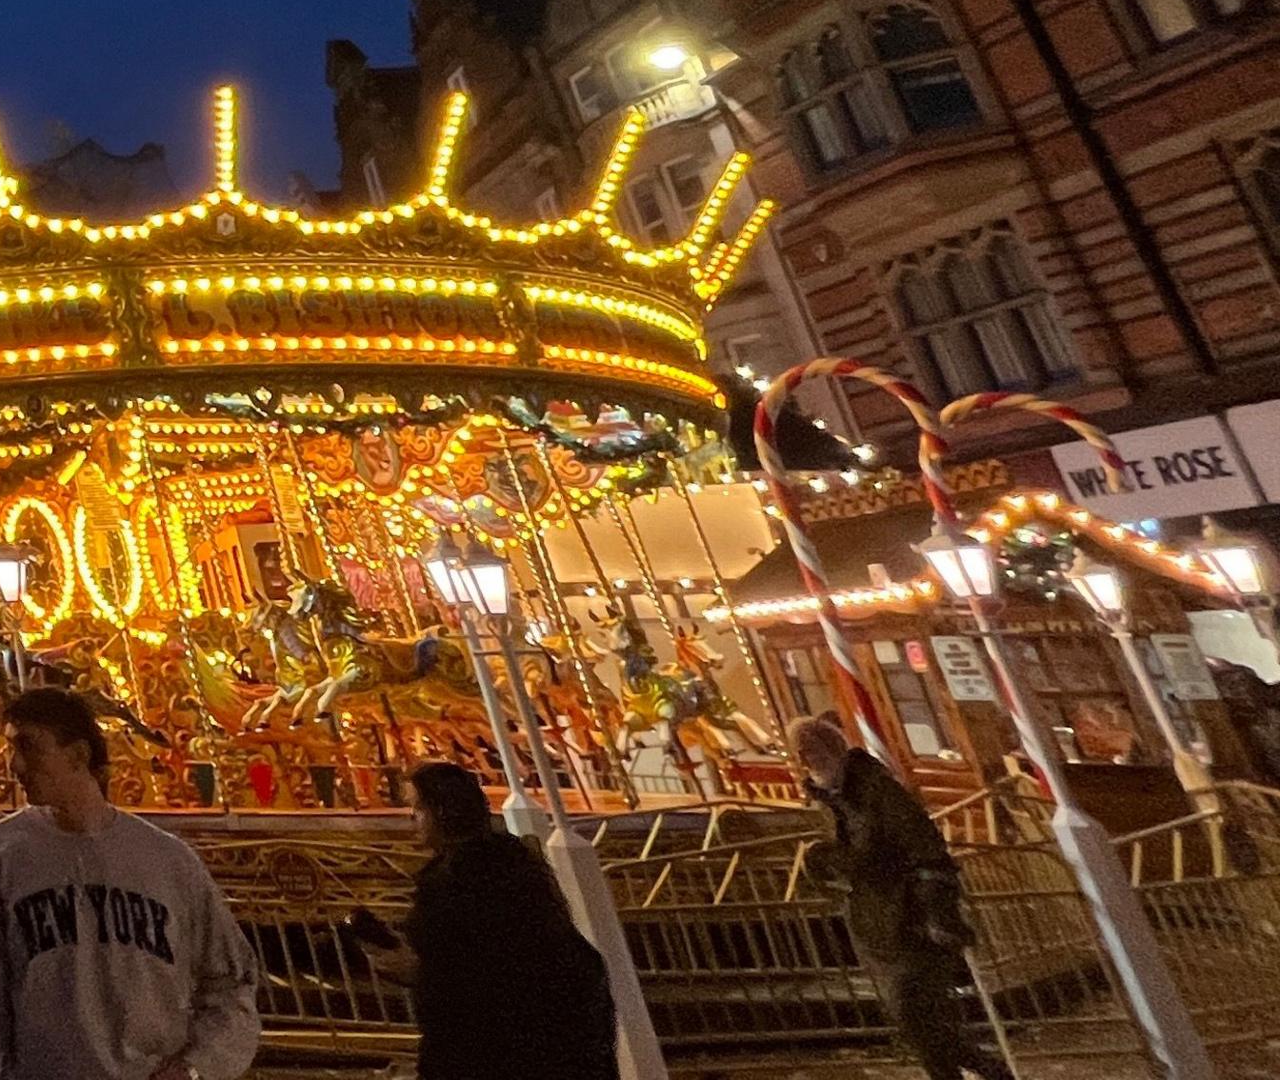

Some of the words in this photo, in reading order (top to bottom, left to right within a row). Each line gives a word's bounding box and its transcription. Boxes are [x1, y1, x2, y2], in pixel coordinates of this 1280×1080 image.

[1152, 446, 1234, 487] ROSE
[13, 883, 79, 962] NEW
[84, 883, 175, 965] YORK
